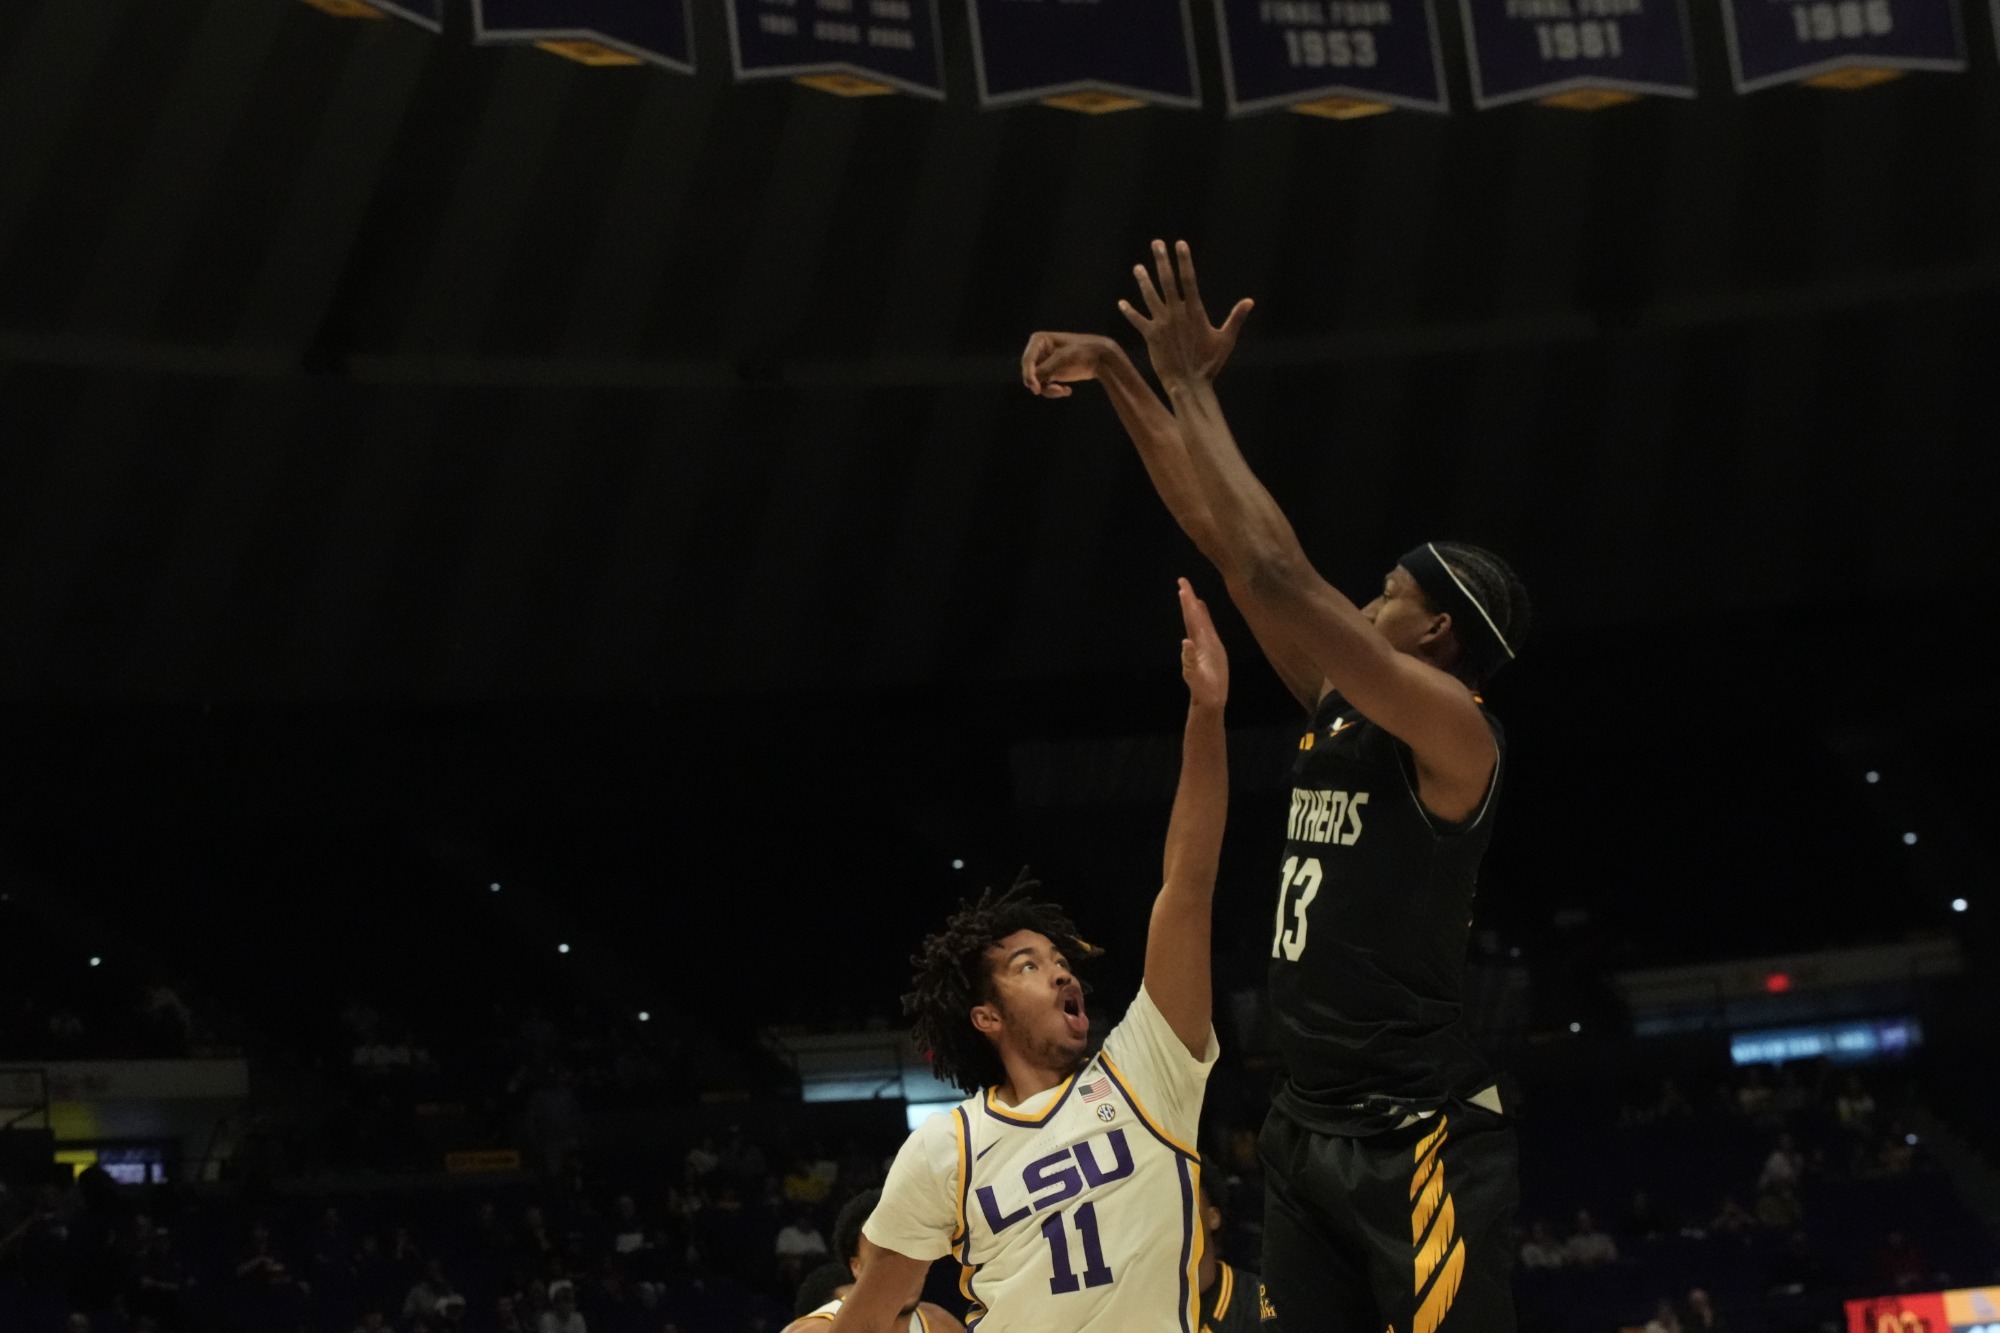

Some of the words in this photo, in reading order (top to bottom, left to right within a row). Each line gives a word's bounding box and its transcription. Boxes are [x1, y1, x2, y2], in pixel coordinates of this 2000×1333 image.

[1284, 28, 1377, 68] 1953
[1272, 856, 1323, 962] 13
[1098, 1104, 1115, 1121] SEC
[976, 1128, 1134, 1235] LSU
[1041, 1201, 1113, 1295] 11
